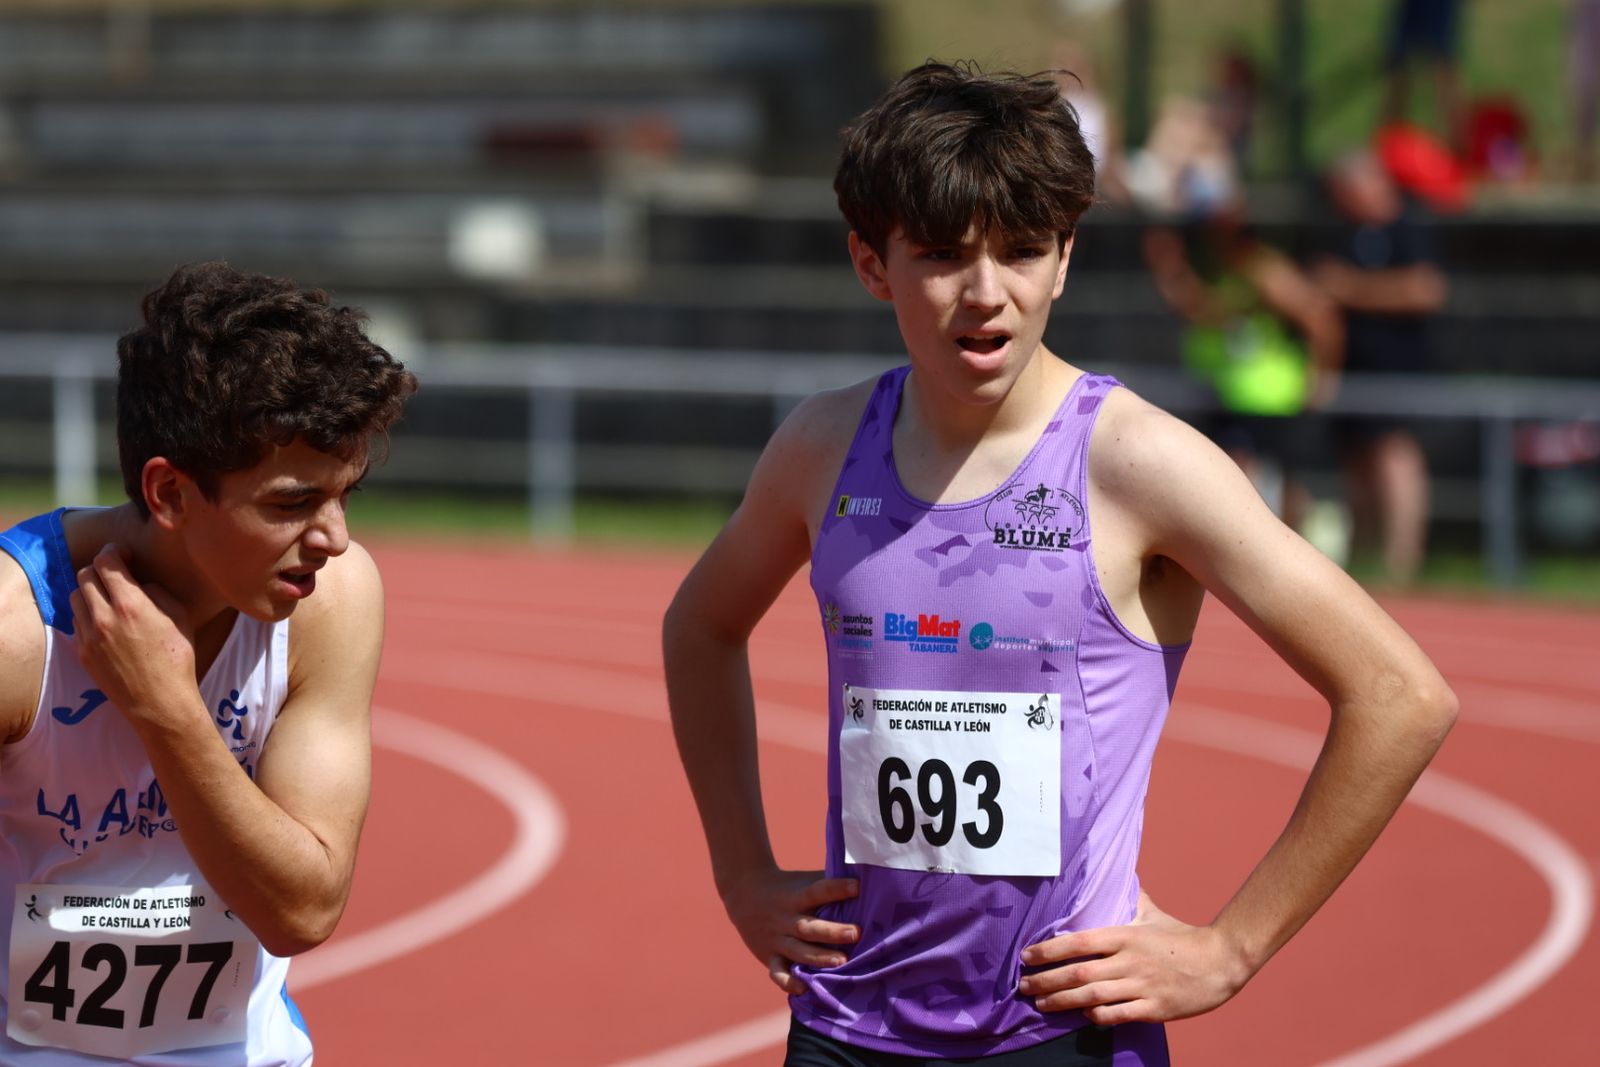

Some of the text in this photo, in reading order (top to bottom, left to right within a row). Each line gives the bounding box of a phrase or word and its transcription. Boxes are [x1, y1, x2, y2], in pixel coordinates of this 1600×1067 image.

[993, 528, 1072, 549] BLUME
[843, 614, 873, 625] asuntos
[884, 612, 960, 640] BigMat
[843, 625, 873, 636] sociales
[909, 643, 958, 653] TABANERA
[872, 698, 1007, 714] FEDERACIÓN DE ATLETISMO
[889, 718, 991, 733] DE CASTILLA Y LEÓN
[877, 756, 1004, 849] 693
[63, 895, 205, 910] FEDERACIÓN DE ATLETISMO
[82, 914, 191, 928] DE CASTILLA Y LEÓN
[24, 940, 234, 1029] 4277
